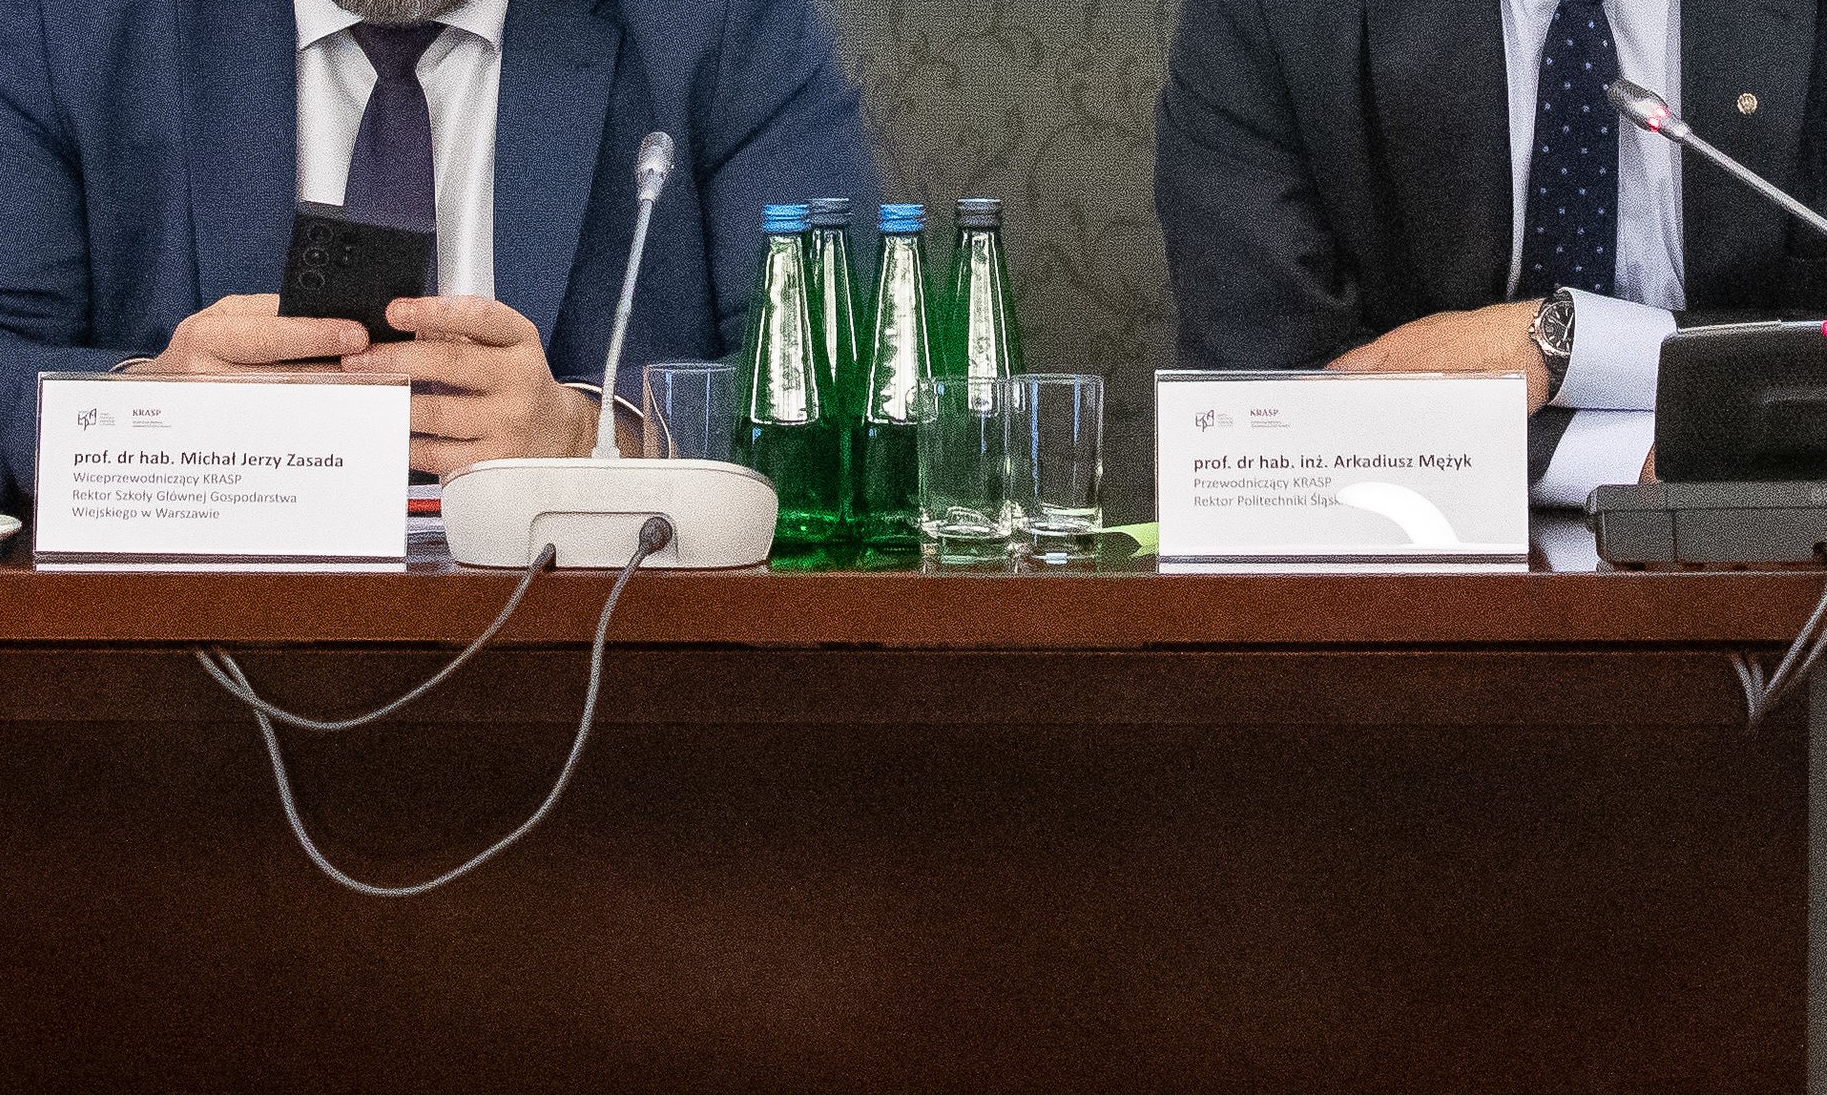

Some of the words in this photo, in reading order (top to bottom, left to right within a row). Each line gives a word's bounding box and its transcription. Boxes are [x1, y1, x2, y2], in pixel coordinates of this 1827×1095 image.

[1250, 408, 1279, 417] KRASP
[74, 450, 111, 466] prof.
[117, 451, 134, 464] dr
[140, 451, 174, 464] hab.
[181, 452, 236, 465] Michał
[241, 453, 281, 469] Jerzy
[287, 454, 344, 468] Zasada
[1194, 455, 1231, 472] prof.
[1237, 456, 1254, 469] dr
[1260, 455, 1294, 469] hab.
[1301, 455, 1328, 468] inż.
[1334, 454, 1413, 469] Arkadiusz
[1419, 454, 1472, 471] Mężyk
[73, 472, 200, 488] Wiceprzewodniczący
[203, 474, 242, 485] KRASP
[1194, 478, 1289, 491] Przewodniczący
[1293, 477, 1332, 488] KRASP
[73, 490, 111, 500] Rektor
[116, 490, 152, 503] Szkoły
[156, 491, 206, 504] Głównej
[210, 491, 297, 506] Gospodarstwa
[1194, 496, 1233, 506] Rektor
[1238, 494, 1307, 506] Politechniki
[1311, 492, 1356, 509] Śląsk
[72, 507, 137, 520] Wiejskiego
[155, 508, 220, 520] Warszawie
